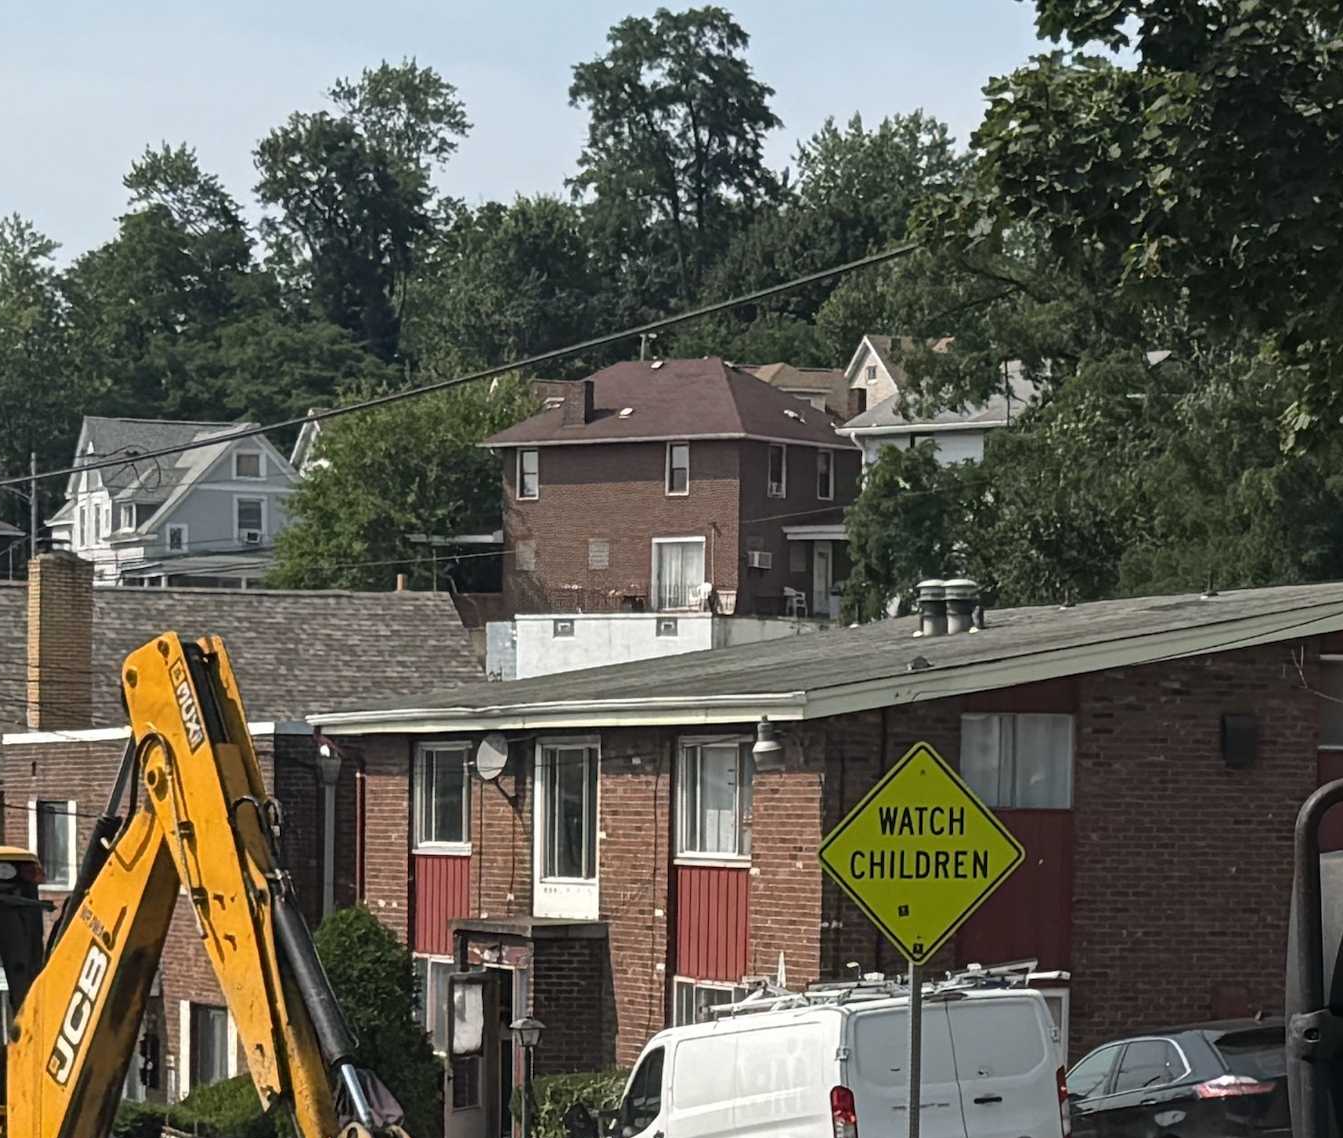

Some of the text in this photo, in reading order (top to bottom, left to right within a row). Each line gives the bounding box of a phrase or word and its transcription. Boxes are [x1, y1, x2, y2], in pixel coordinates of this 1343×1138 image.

[879, 806, 965, 836] WATCH
[850, 850, 989, 880] CHILDREN
[56, 944, 109, 1085] JCB
